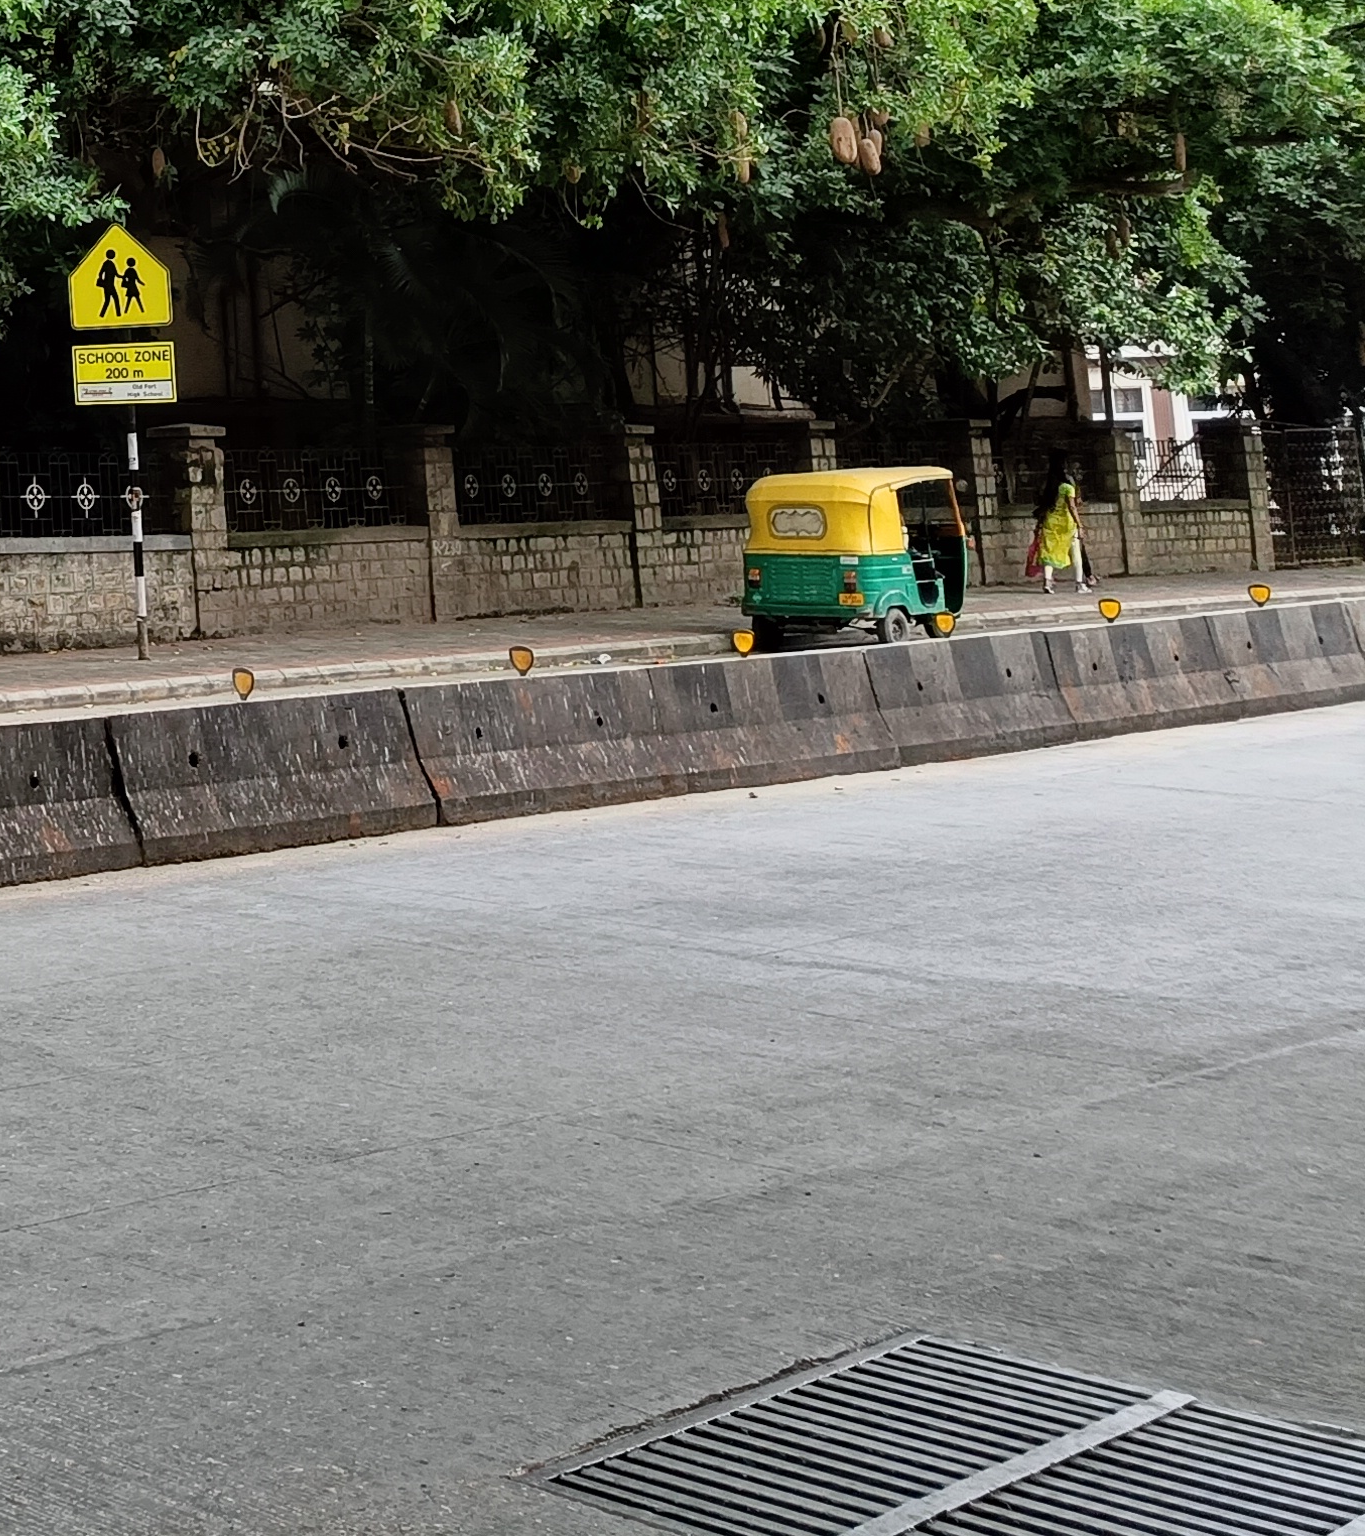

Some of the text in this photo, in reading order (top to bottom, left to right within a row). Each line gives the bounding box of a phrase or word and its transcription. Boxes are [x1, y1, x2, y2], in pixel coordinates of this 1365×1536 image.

[78, 350, 170, 365] SCHOOL ZONE
[105, 367, 144, 379] 200 m
